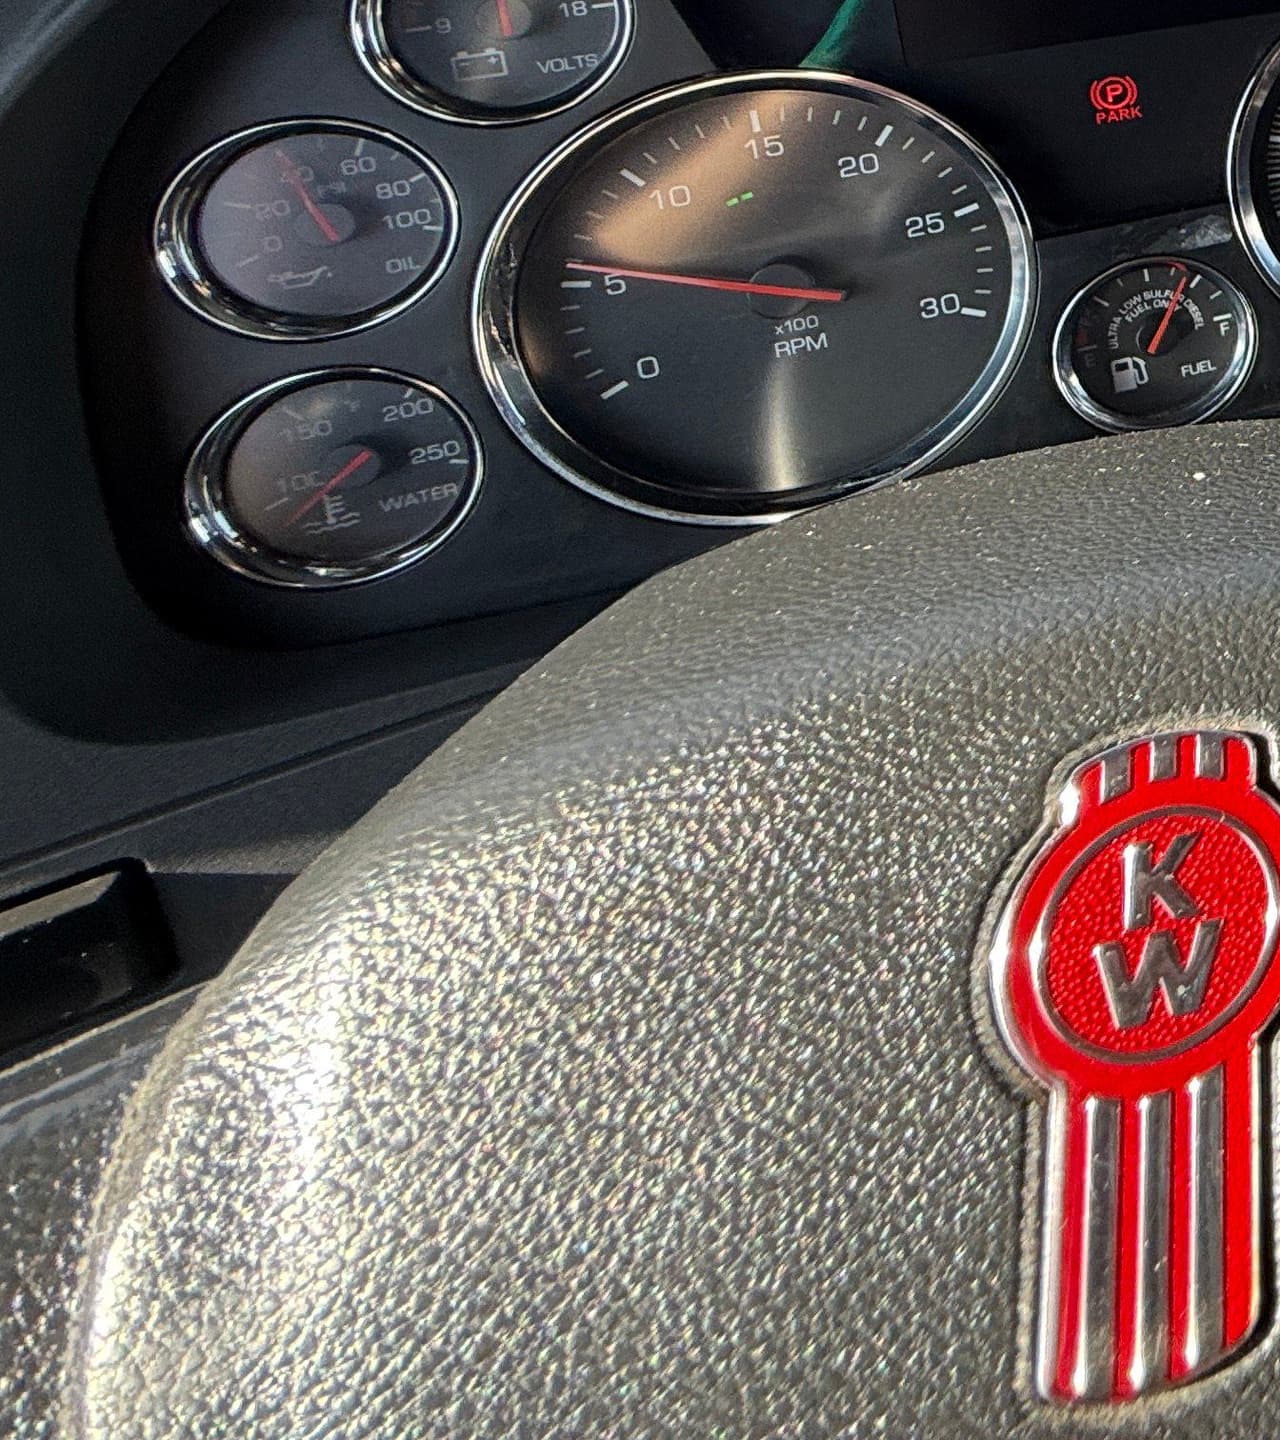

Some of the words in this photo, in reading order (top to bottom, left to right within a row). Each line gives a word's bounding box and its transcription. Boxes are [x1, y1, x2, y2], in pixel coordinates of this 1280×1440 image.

[559, 0, 589, 19] 18
[434, 17, 453, 35] 9
[535, 53, 599, 75] VOLTS
[1095, 105, 1143, 126] PARK
[744, 134, 786, 161] 15
[340, 156, 377, 176] 60
[837, 152, 880, 179] 20
[376, 180, 412, 201] 80
[649, 183, 693, 211] 10
[254, 199, 292, 221] 20
[382, 208, 433, 232] 100
[904, 211, 946, 240] 25
[385, 257, 422, 275] OIL
[604, 273, 628, 296] 5
[919, 293, 961, 320] 30
[1124, 300, 1152, 324] FUEL
[1152, 299, 1182, 313] ONY
[774, 314, 820, 336] x100
[1107, 315, 1123, 350] ULTRA
[1119, 293, 1144, 314] LOW
[1182, 298, 1206, 331] DIESEL
[1219, 321, 1231, 337] F
[774, 331, 829, 359] RPM
[636, 356, 661, 380] 0
[1180, 359, 1217, 378] FUEL
[383, 397, 435, 423] 200
[409, 441, 462, 465] 250
[378, 483, 458, 512] WATER
